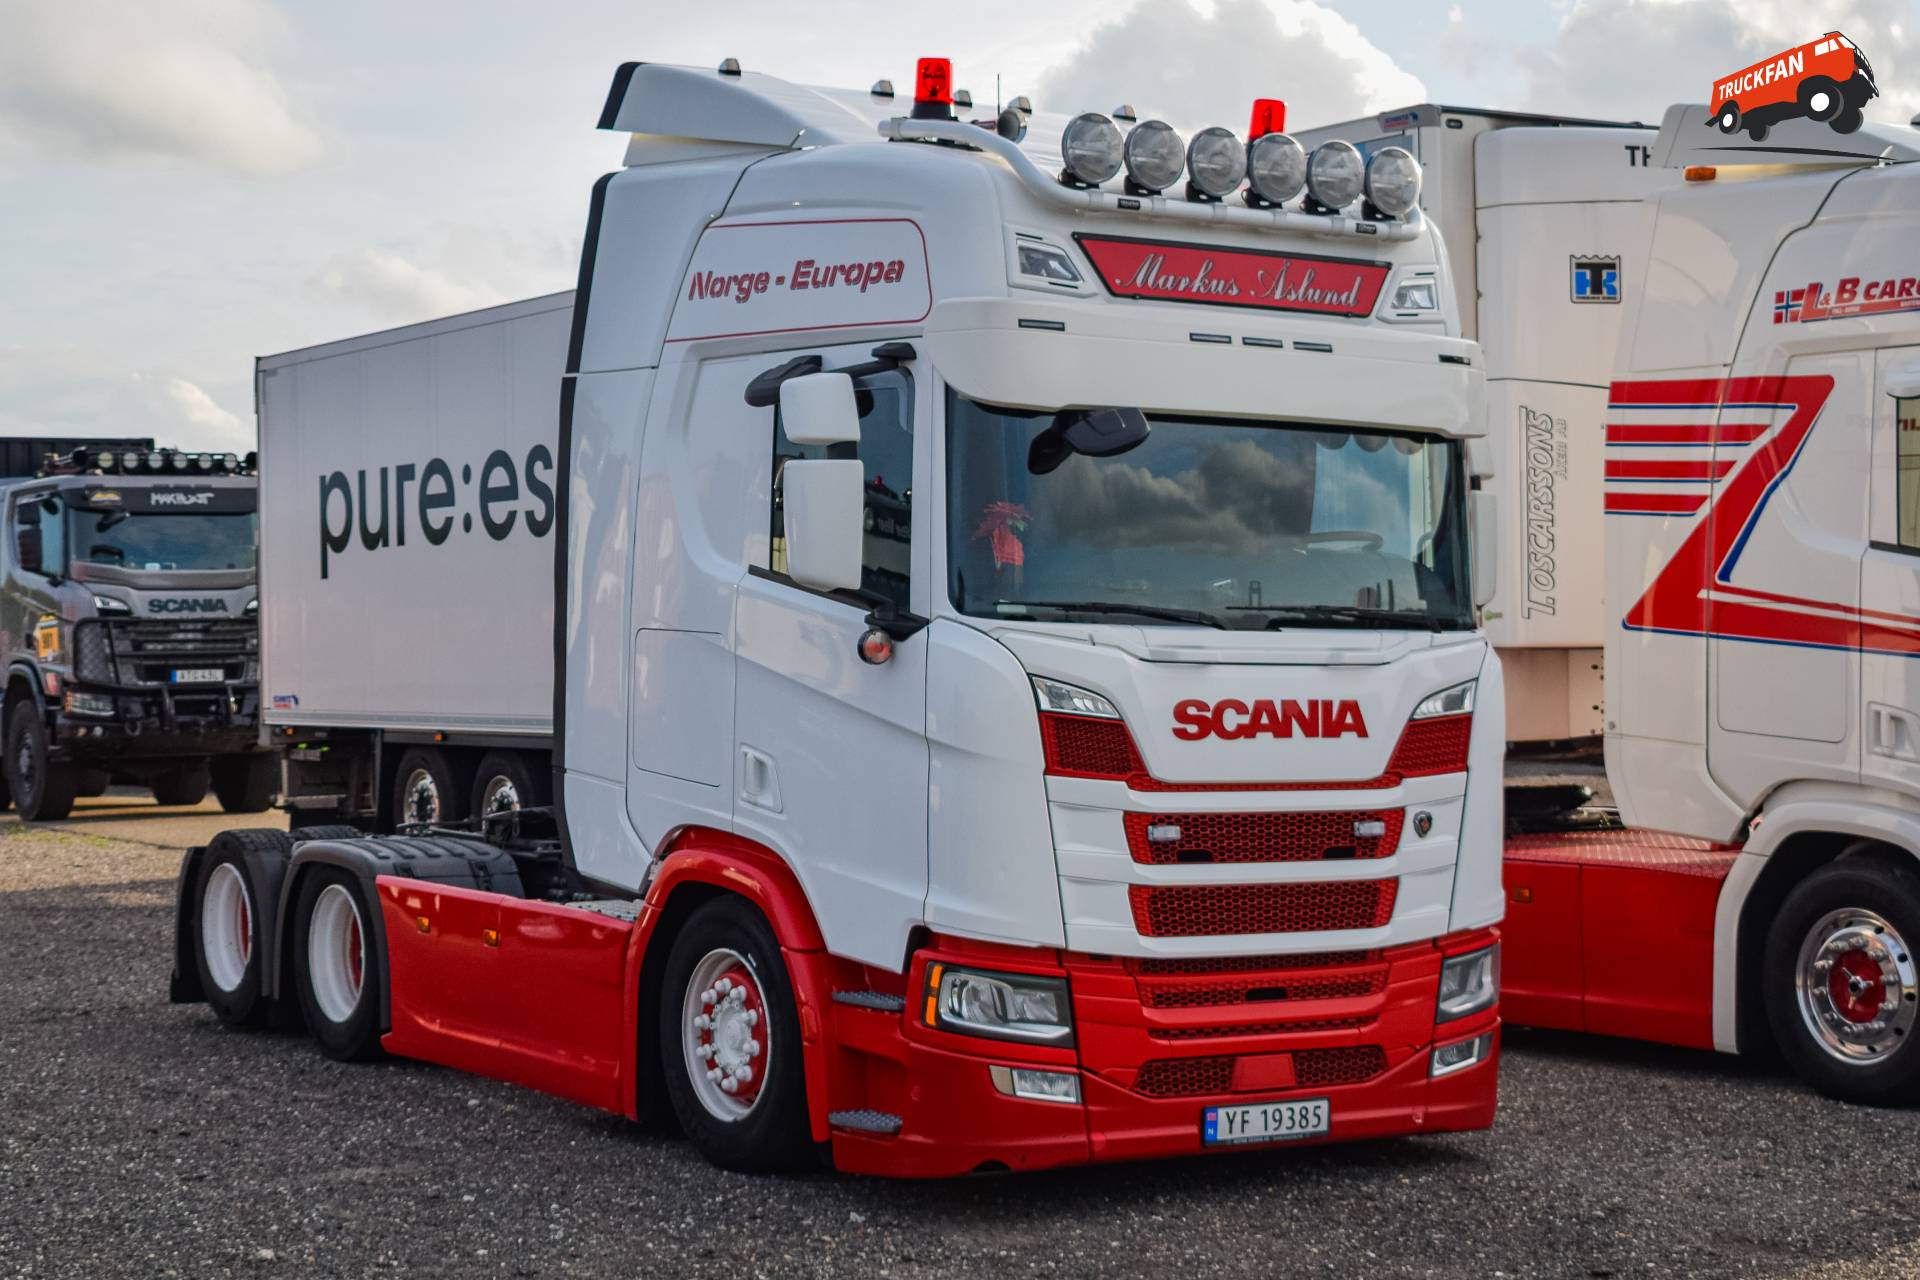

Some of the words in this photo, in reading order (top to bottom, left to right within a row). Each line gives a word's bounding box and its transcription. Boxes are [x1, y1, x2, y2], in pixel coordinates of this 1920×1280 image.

[688, 270, 770, 303] Norge
[790, 260, 904, 293] Europa
[1115, 253, 1240, 296] Markus
[148, 598, 228, 613] SCANIA
[1172, 699, 1369, 741] SCANIA
[1225, 1110, 1250, 1134] YF
[1261, 1105, 1321, 1131] 19385
